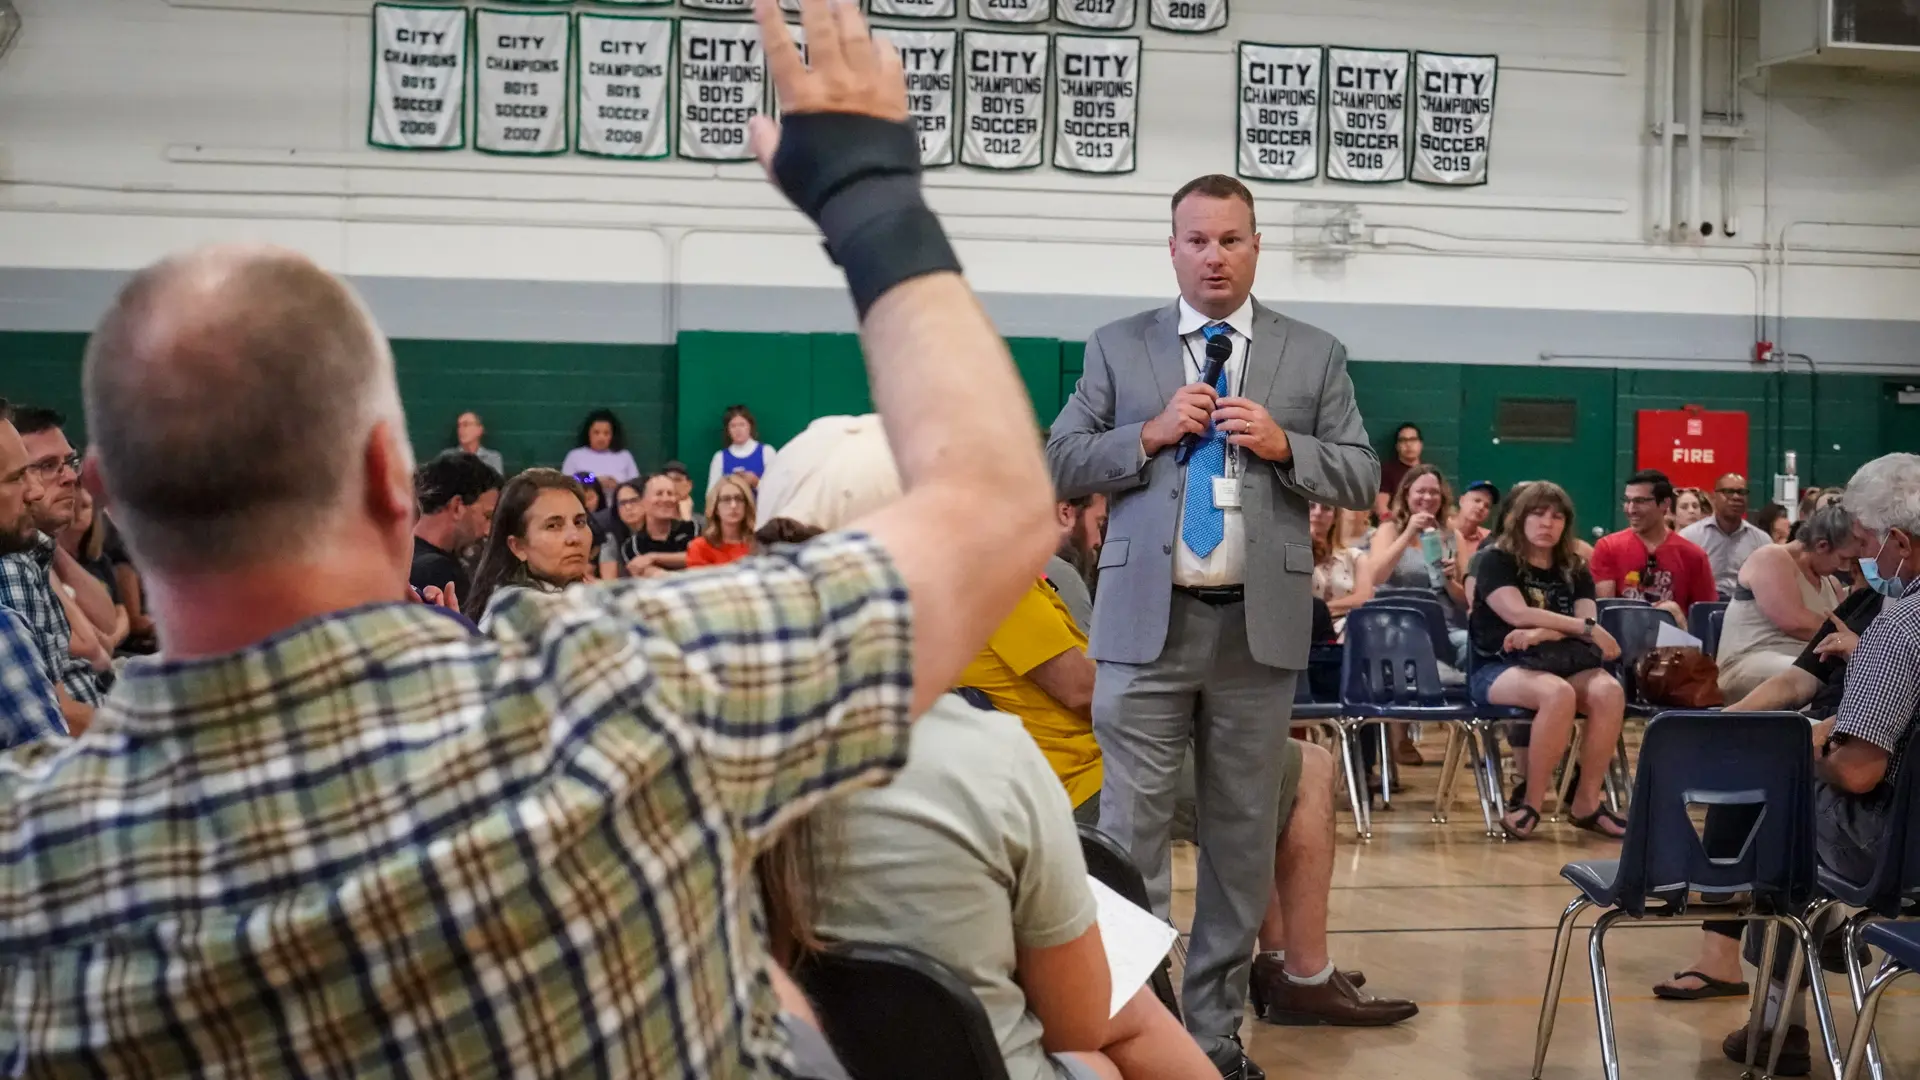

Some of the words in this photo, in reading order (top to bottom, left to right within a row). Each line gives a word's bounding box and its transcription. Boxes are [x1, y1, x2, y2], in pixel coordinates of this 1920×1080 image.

[1074, 0, 1115, 13] 2017
[1169, 2, 1206, 19] 2018
[396, 28, 445, 45] CITY
[498, 36, 544, 49] CITY
[600, 41, 646, 54] CITY
[689, 37, 756, 62] CITY
[384, 49, 457, 68] CHAMPIONS
[487, 56, 559, 72] CHAMPIONS
[901, 48, 945, 70] ITY
[971, 49, 1036, 74] CITY
[1064, 54, 1128, 77] CITY
[589, 62, 662, 77] CHAMPIONS
[682, 64, 762, 83] CHAMPIONS
[1248, 62, 1311, 86] CITY
[1335, 66, 1398, 90] CITY
[401, 75, 436, 90] BOYS
[504, 81, 538, 95] BOYS
[905, 74, 950, 90] PIONS
[967, 75, 1042, 94] CHAMPIONS
[1060, 79, 1132, 98] CHAMPIONS
[1423, 71, 1484, 95] CITY
[607, 84, 640, 98] BOYS
[700, 85, 743, 103] BOYS
[1243, 86, 1317, 106] CHAMPIONS
[393, 96, 444, 113] SOCCER
[982, 96, 1024, 114] BOYS
[1331, 90, 1402, 110] CHAMPIONS
[1420, 94, 1489, 115] CHAMPIONS
[496, 104, 548, 118] SOCCER
[598, 106, 649, 121] SOCCER
[1073, 101, 1115, 118] BOYS
[1259, 108, 1298, 126] BOYS
[971, 117, 1037, 134] SOCCER
[1064, 120, 1130, 138] SOCCER
[1347, 112, 1386, 129] BOYS
[1432, 116, 1474, 134] BOYS
[503, 127, 541, 141] 2007
[605, 129, 643, 144] 2008
[701, 127, 743, 144] 2009
[1246, 128, 1311, 145] SOCCER
[1334, 131, 1398, 149] SOCCER
[984, 138, 1022, 154] 2012
[1076, 142, 1113, 158] 2013
[1420, 134, 1485, 152] SOCCER
[1259, 148, 1295, 165] 2017
[1347, 152, 1383, 169] 2018
[1432, 156, 1470, 171] 2019
[1673, 448, 1715, 463] FIRE
